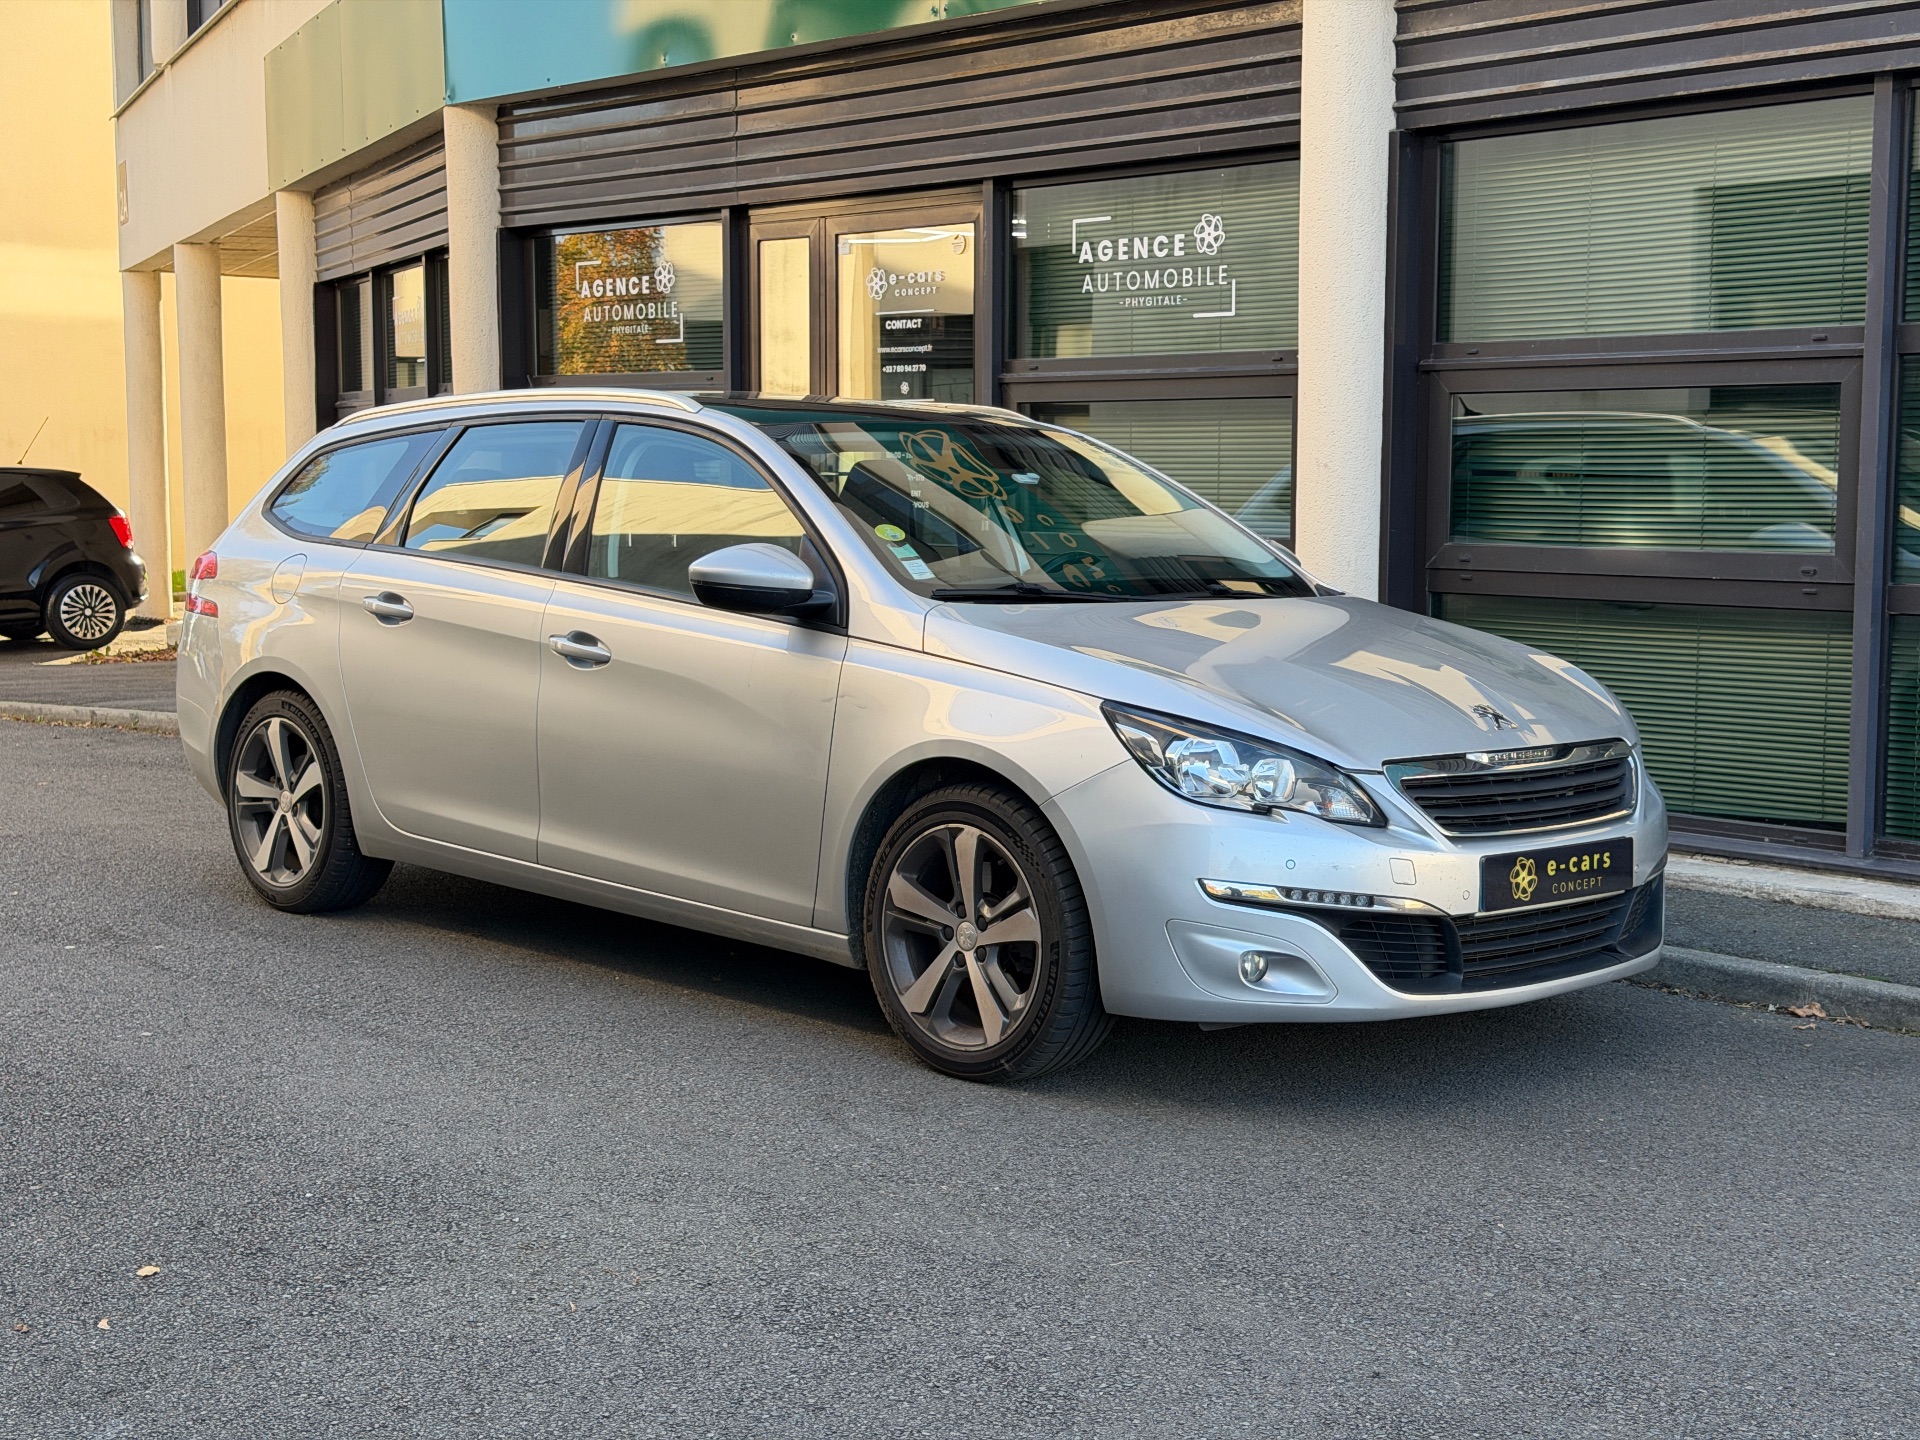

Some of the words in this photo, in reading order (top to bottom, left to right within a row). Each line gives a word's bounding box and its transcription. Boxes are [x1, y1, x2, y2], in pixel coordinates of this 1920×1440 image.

[1078, 233, 1186, 264] AGENCE
[580, 275, 651, 299] AGENCE
[889, 271, 943, 286] e-cars
[1081, 264, 1228, 294] AUTOMOBILE
[894, 286, 937, 297] CONCEPT
[583, 301, 679, 323] AUTOMOBILE
[885, 318, 922, 330] CONTACT
[1546, 851, 1611, 876] e-cars
[1551, 876, 1603, 894] CONCEPT
[1031, 964, 1058, 1035] MICHELIN
